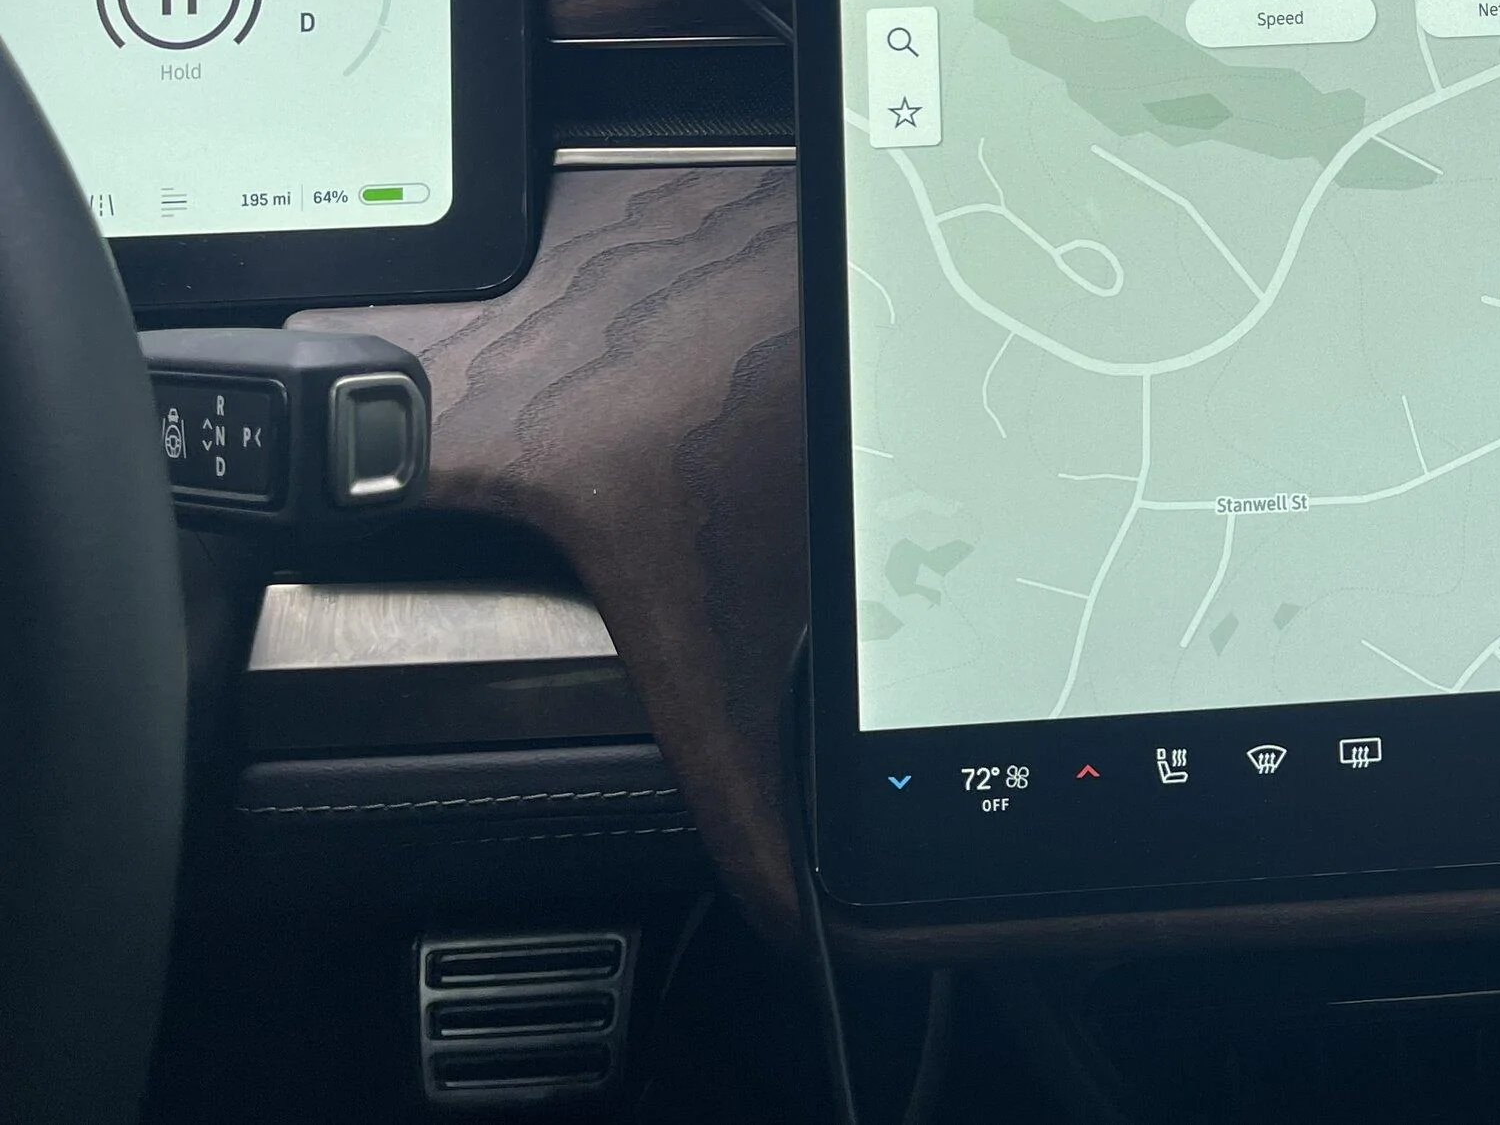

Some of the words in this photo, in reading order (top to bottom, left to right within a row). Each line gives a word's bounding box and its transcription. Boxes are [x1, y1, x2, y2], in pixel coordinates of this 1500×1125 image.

[300, 13, 315, 33] D
[1257, 10, 1304, 30] Speed
[160, 64, 201, 81] Hold
[241, 193, 268, 207] 195
[272, 191, 292, 206] mi
[313, 189, 348, 205] 64%
[216, 395, 225, 416] R
[216, 426, 225, 447] N
[243, 427, 251, 448] P
[216, 457, 226, 477] D
[1217, 495, 1287, 514] Stanwell
[1291, 495, 1307, 510] St
[982, 798, 1009, 813] OFF
